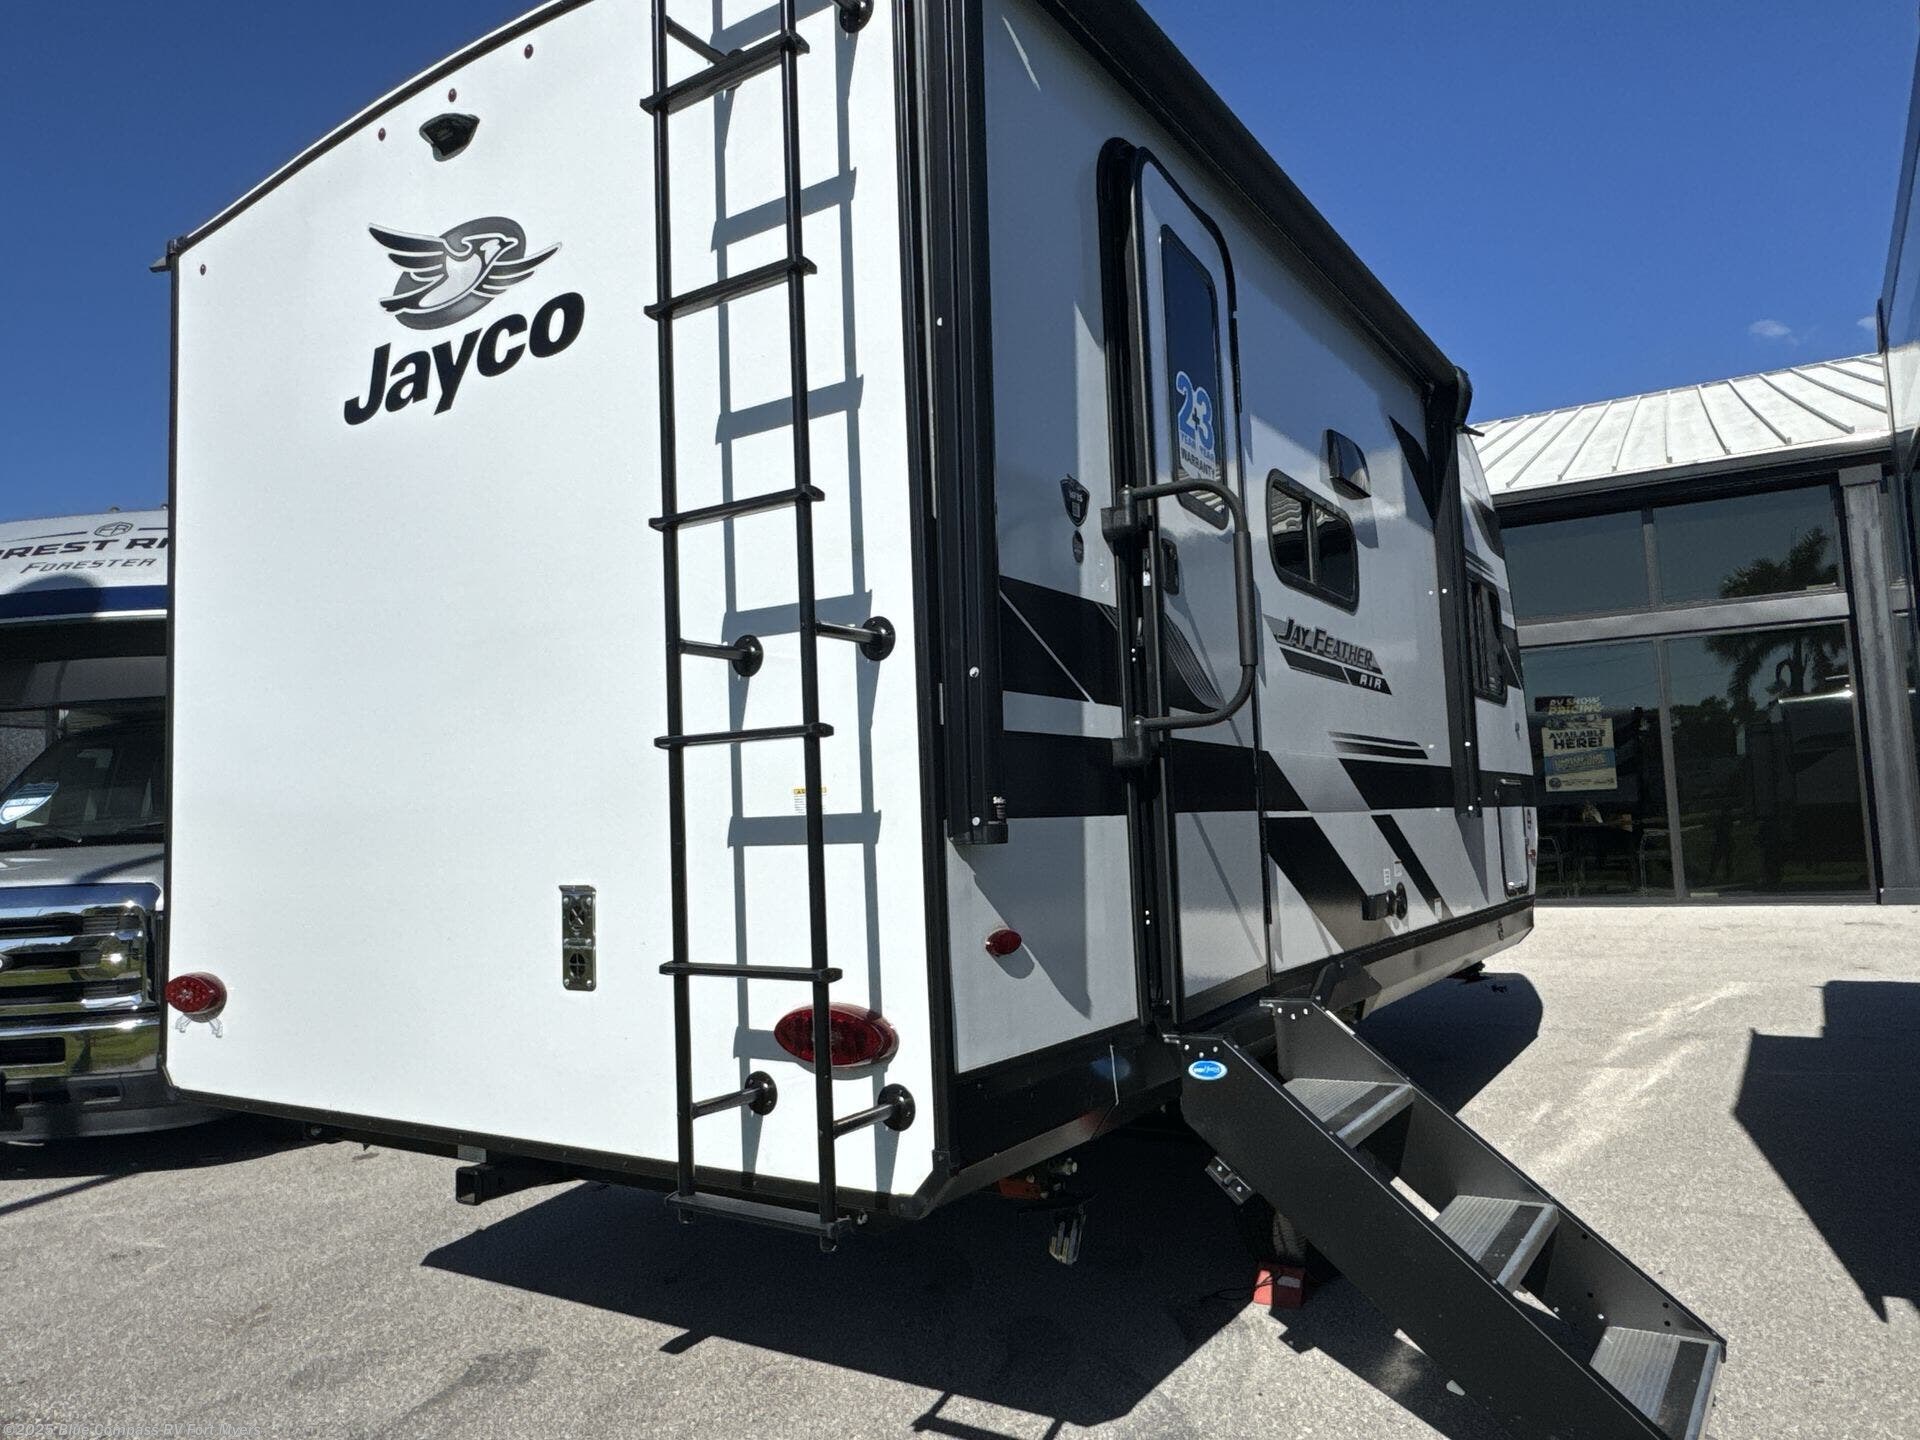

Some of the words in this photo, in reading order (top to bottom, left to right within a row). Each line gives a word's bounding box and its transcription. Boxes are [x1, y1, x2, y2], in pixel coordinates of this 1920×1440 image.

[344, 292, 585, 426] Jayco
[1181, 451, 1216, 478] WARRANTY
[0, 539, 119, 560] REST
[20, 558, 157, 574] FORESTER
[1278, 617, 1310, 646] JAY
[1312, 627, 1374, 667] FEATHER
[1359, 674, 1382, 690] AIR
[1549, 729, 1606, 740] AVAILABLE
[1554, 738, 1603, 749] HERE!
